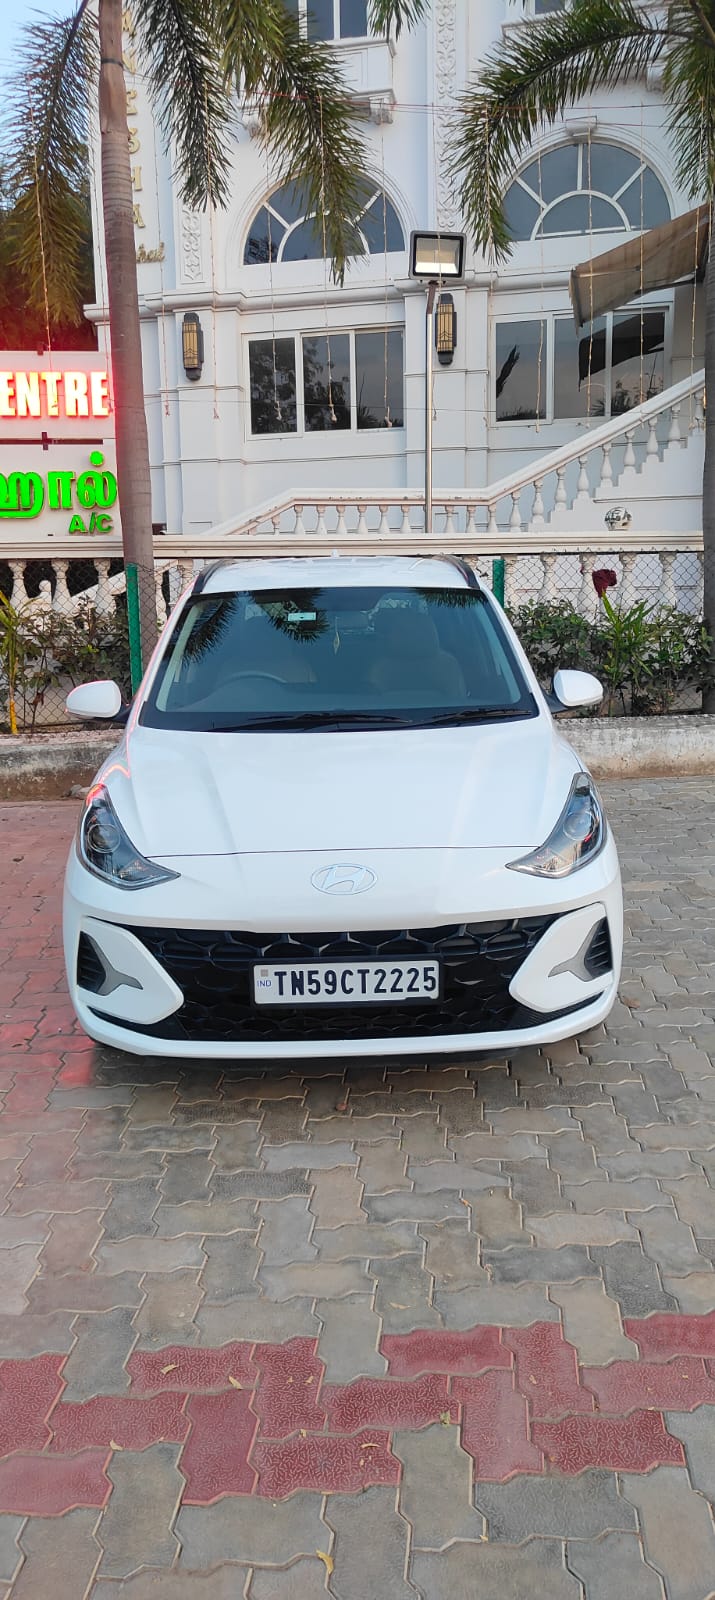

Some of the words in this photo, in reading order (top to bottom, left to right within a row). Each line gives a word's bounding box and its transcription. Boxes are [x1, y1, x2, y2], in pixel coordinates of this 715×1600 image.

[68, 511, 113, 534] A/C
[256, 979, 272, 988] IND
[274, 966, 437, 996] TN59CT2225
